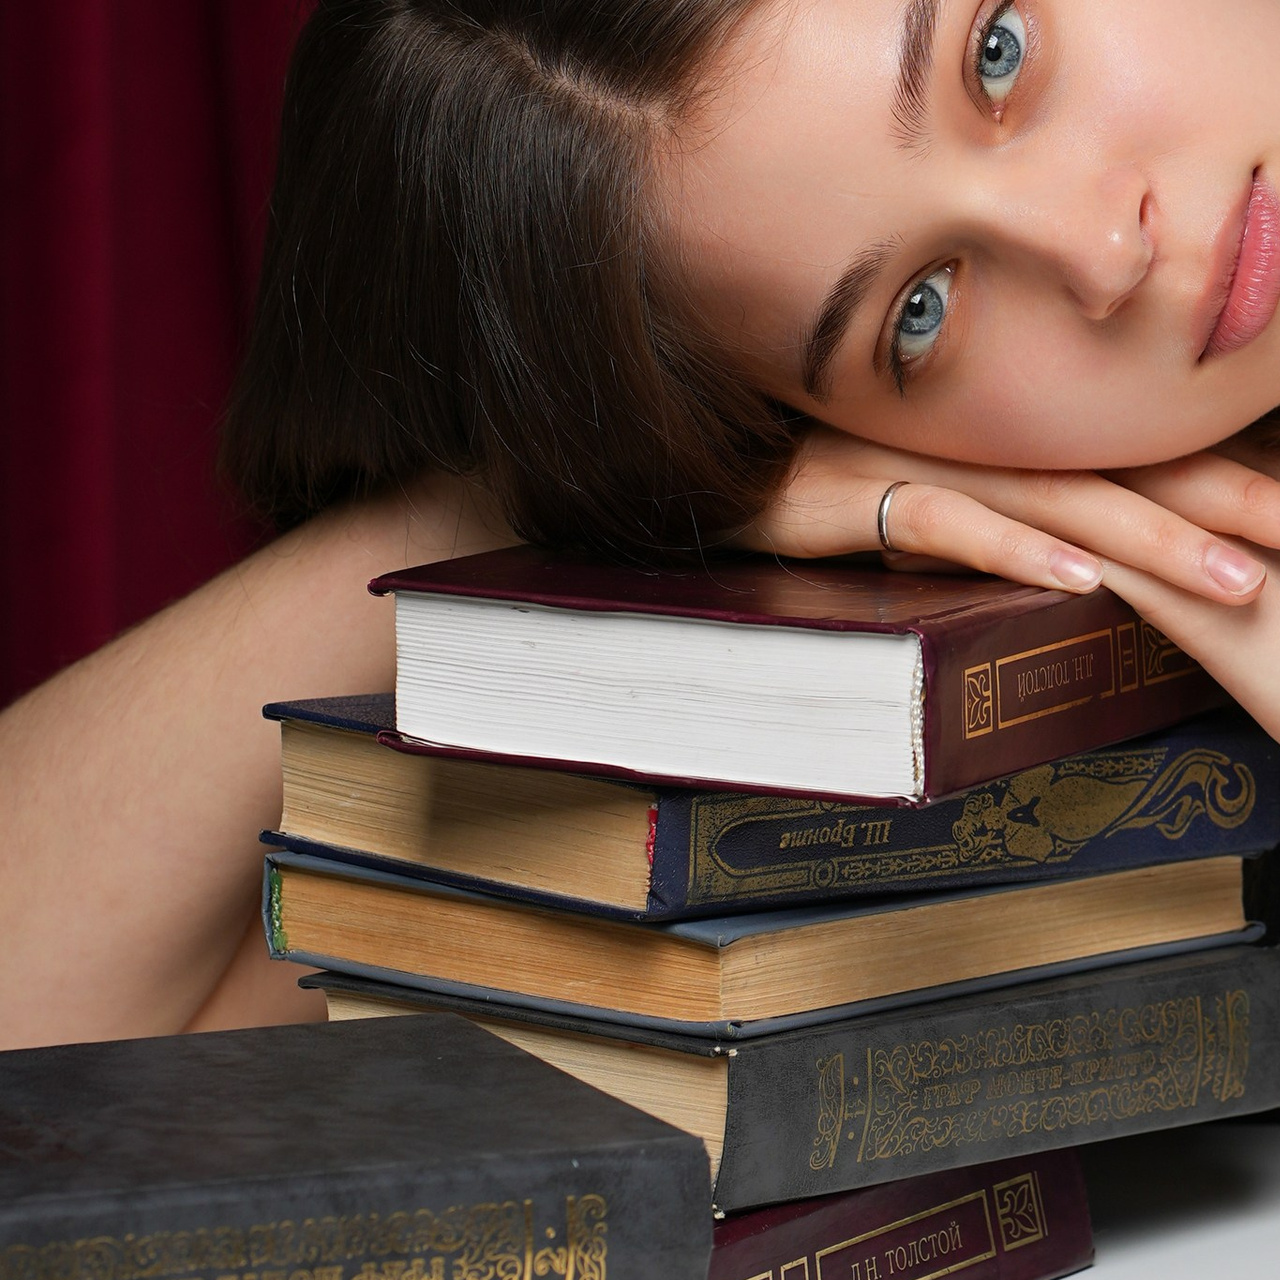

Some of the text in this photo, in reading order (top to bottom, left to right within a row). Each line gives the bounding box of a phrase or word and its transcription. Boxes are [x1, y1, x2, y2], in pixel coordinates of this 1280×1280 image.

[1017, 653, 1094, 702] Л.Н. ТОЛСТОЙ
[779, 819, 893, 850] Ш. Бронте
[1202, 1016, 1216, 1087] ДЮМА
[923, 1049, 1157, 1111] ГРАФ МОНТЕ-КРИСТО
[884, 1220, 963, 1275] ТОЛСТОЙ
